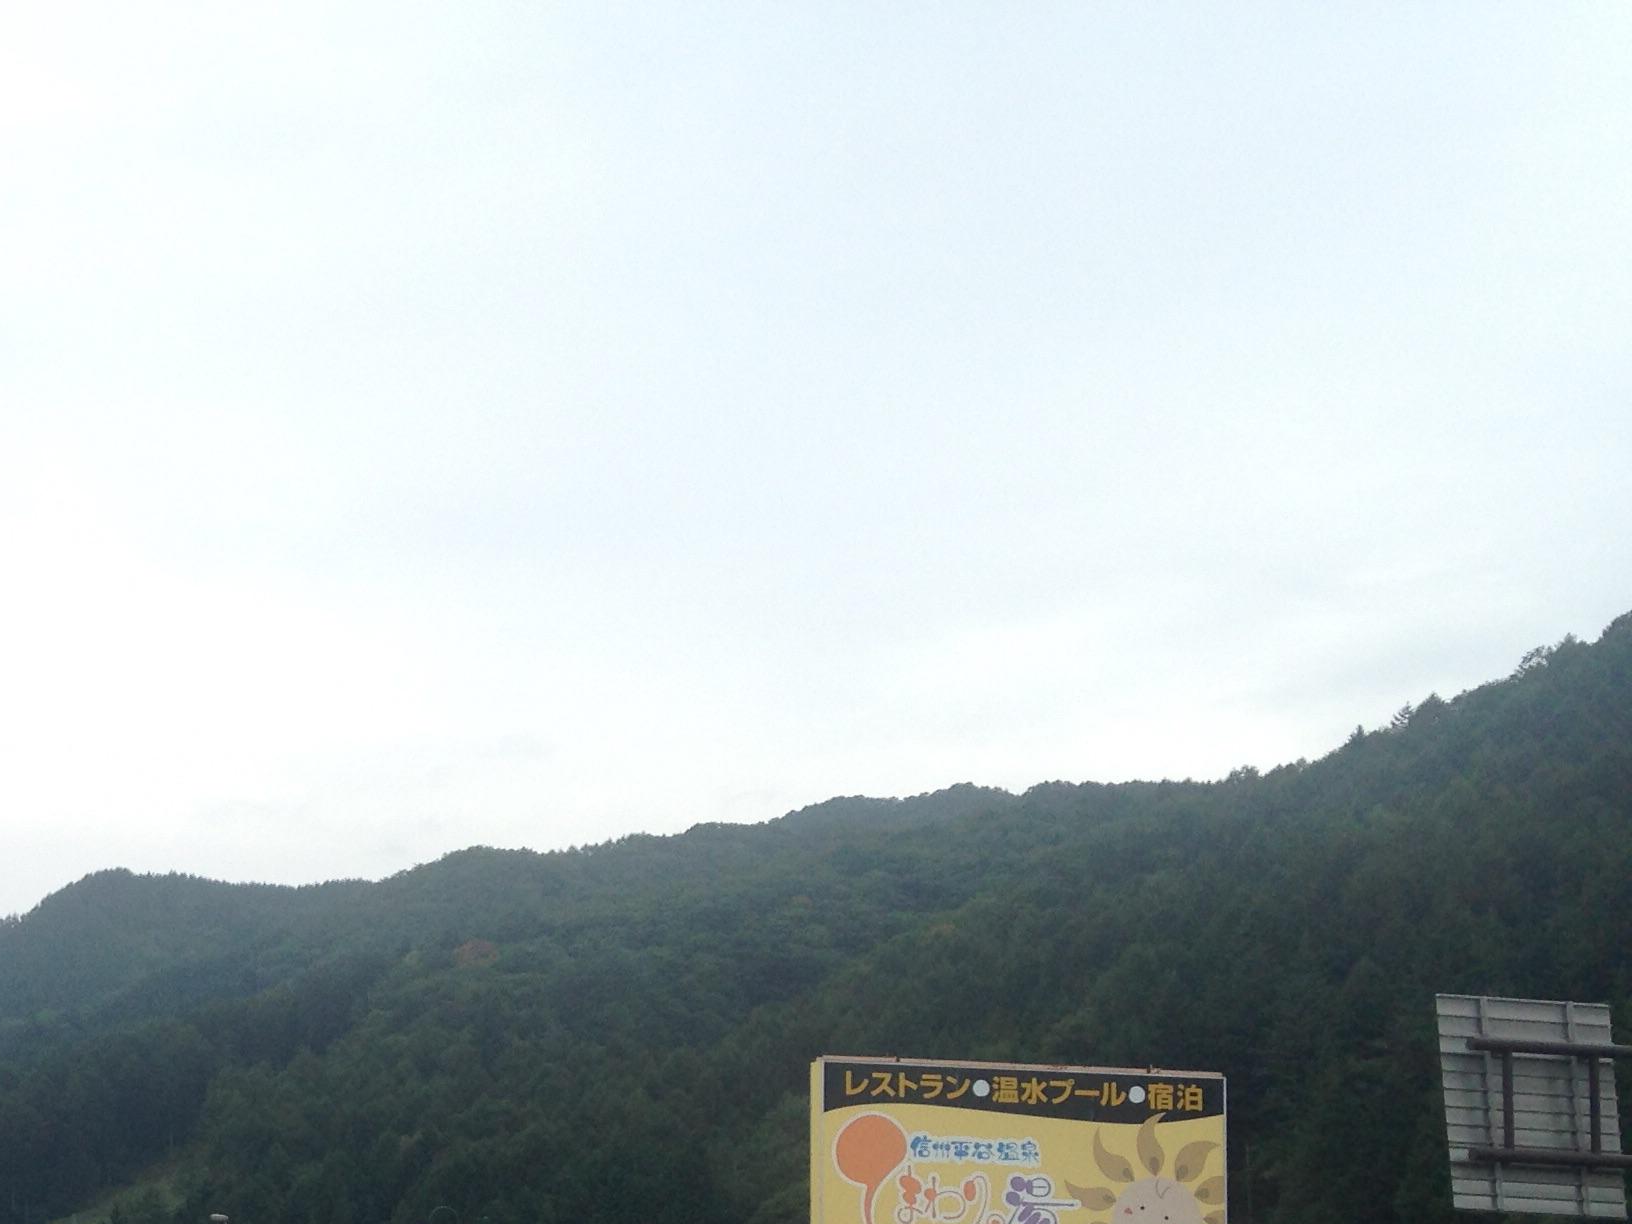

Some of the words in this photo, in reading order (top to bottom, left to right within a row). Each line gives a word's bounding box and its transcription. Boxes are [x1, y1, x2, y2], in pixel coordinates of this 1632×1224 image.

[844, 1069, 970, 1098] レストラン
[992, 1076, 1127, 1107] 温水プール
[1147, 1083, 1204, 1112] 宿泊
